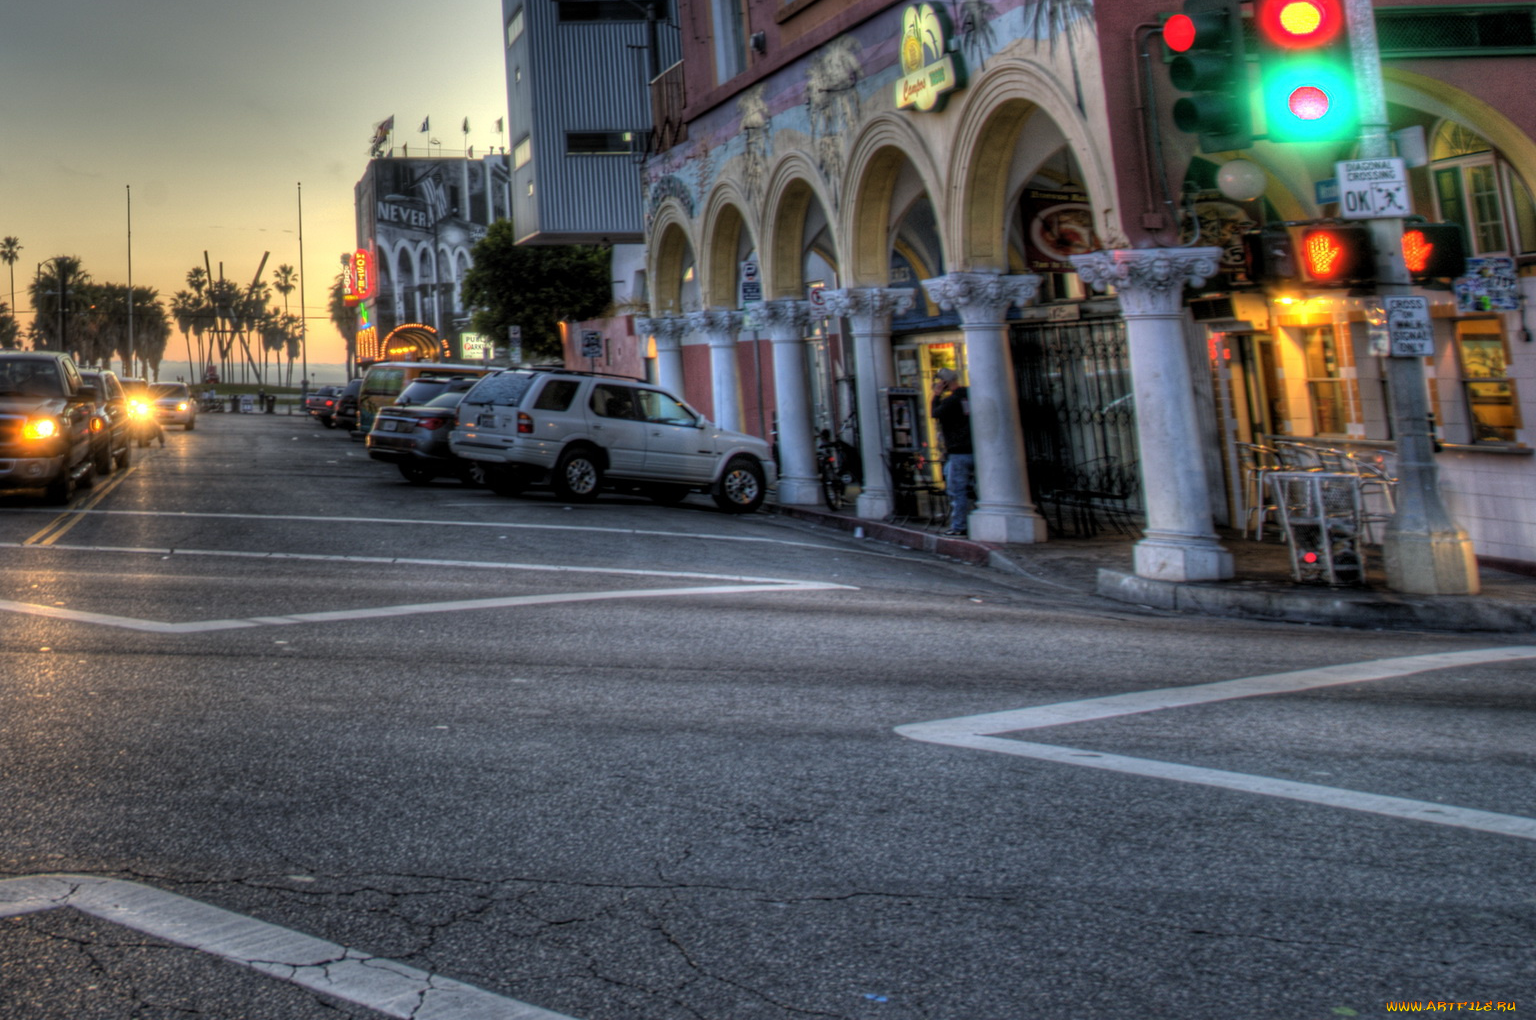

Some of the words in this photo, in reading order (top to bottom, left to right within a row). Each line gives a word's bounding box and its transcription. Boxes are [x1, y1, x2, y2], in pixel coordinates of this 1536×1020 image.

[1345, 161, 1393, 172] DIAGONAL
[1347, 170, 1396, 181] CROSSING
[1346, 190, 1371, 212] OK
[377, 200, 426, 227] NEVER
[356, 253, 366, 294] HOSTEL
[1390, 299, 1423, 310] CROSS
[1394, 331, 1429, 341] SIGNAL
[1400, 343, 1424, 353] ONLY
